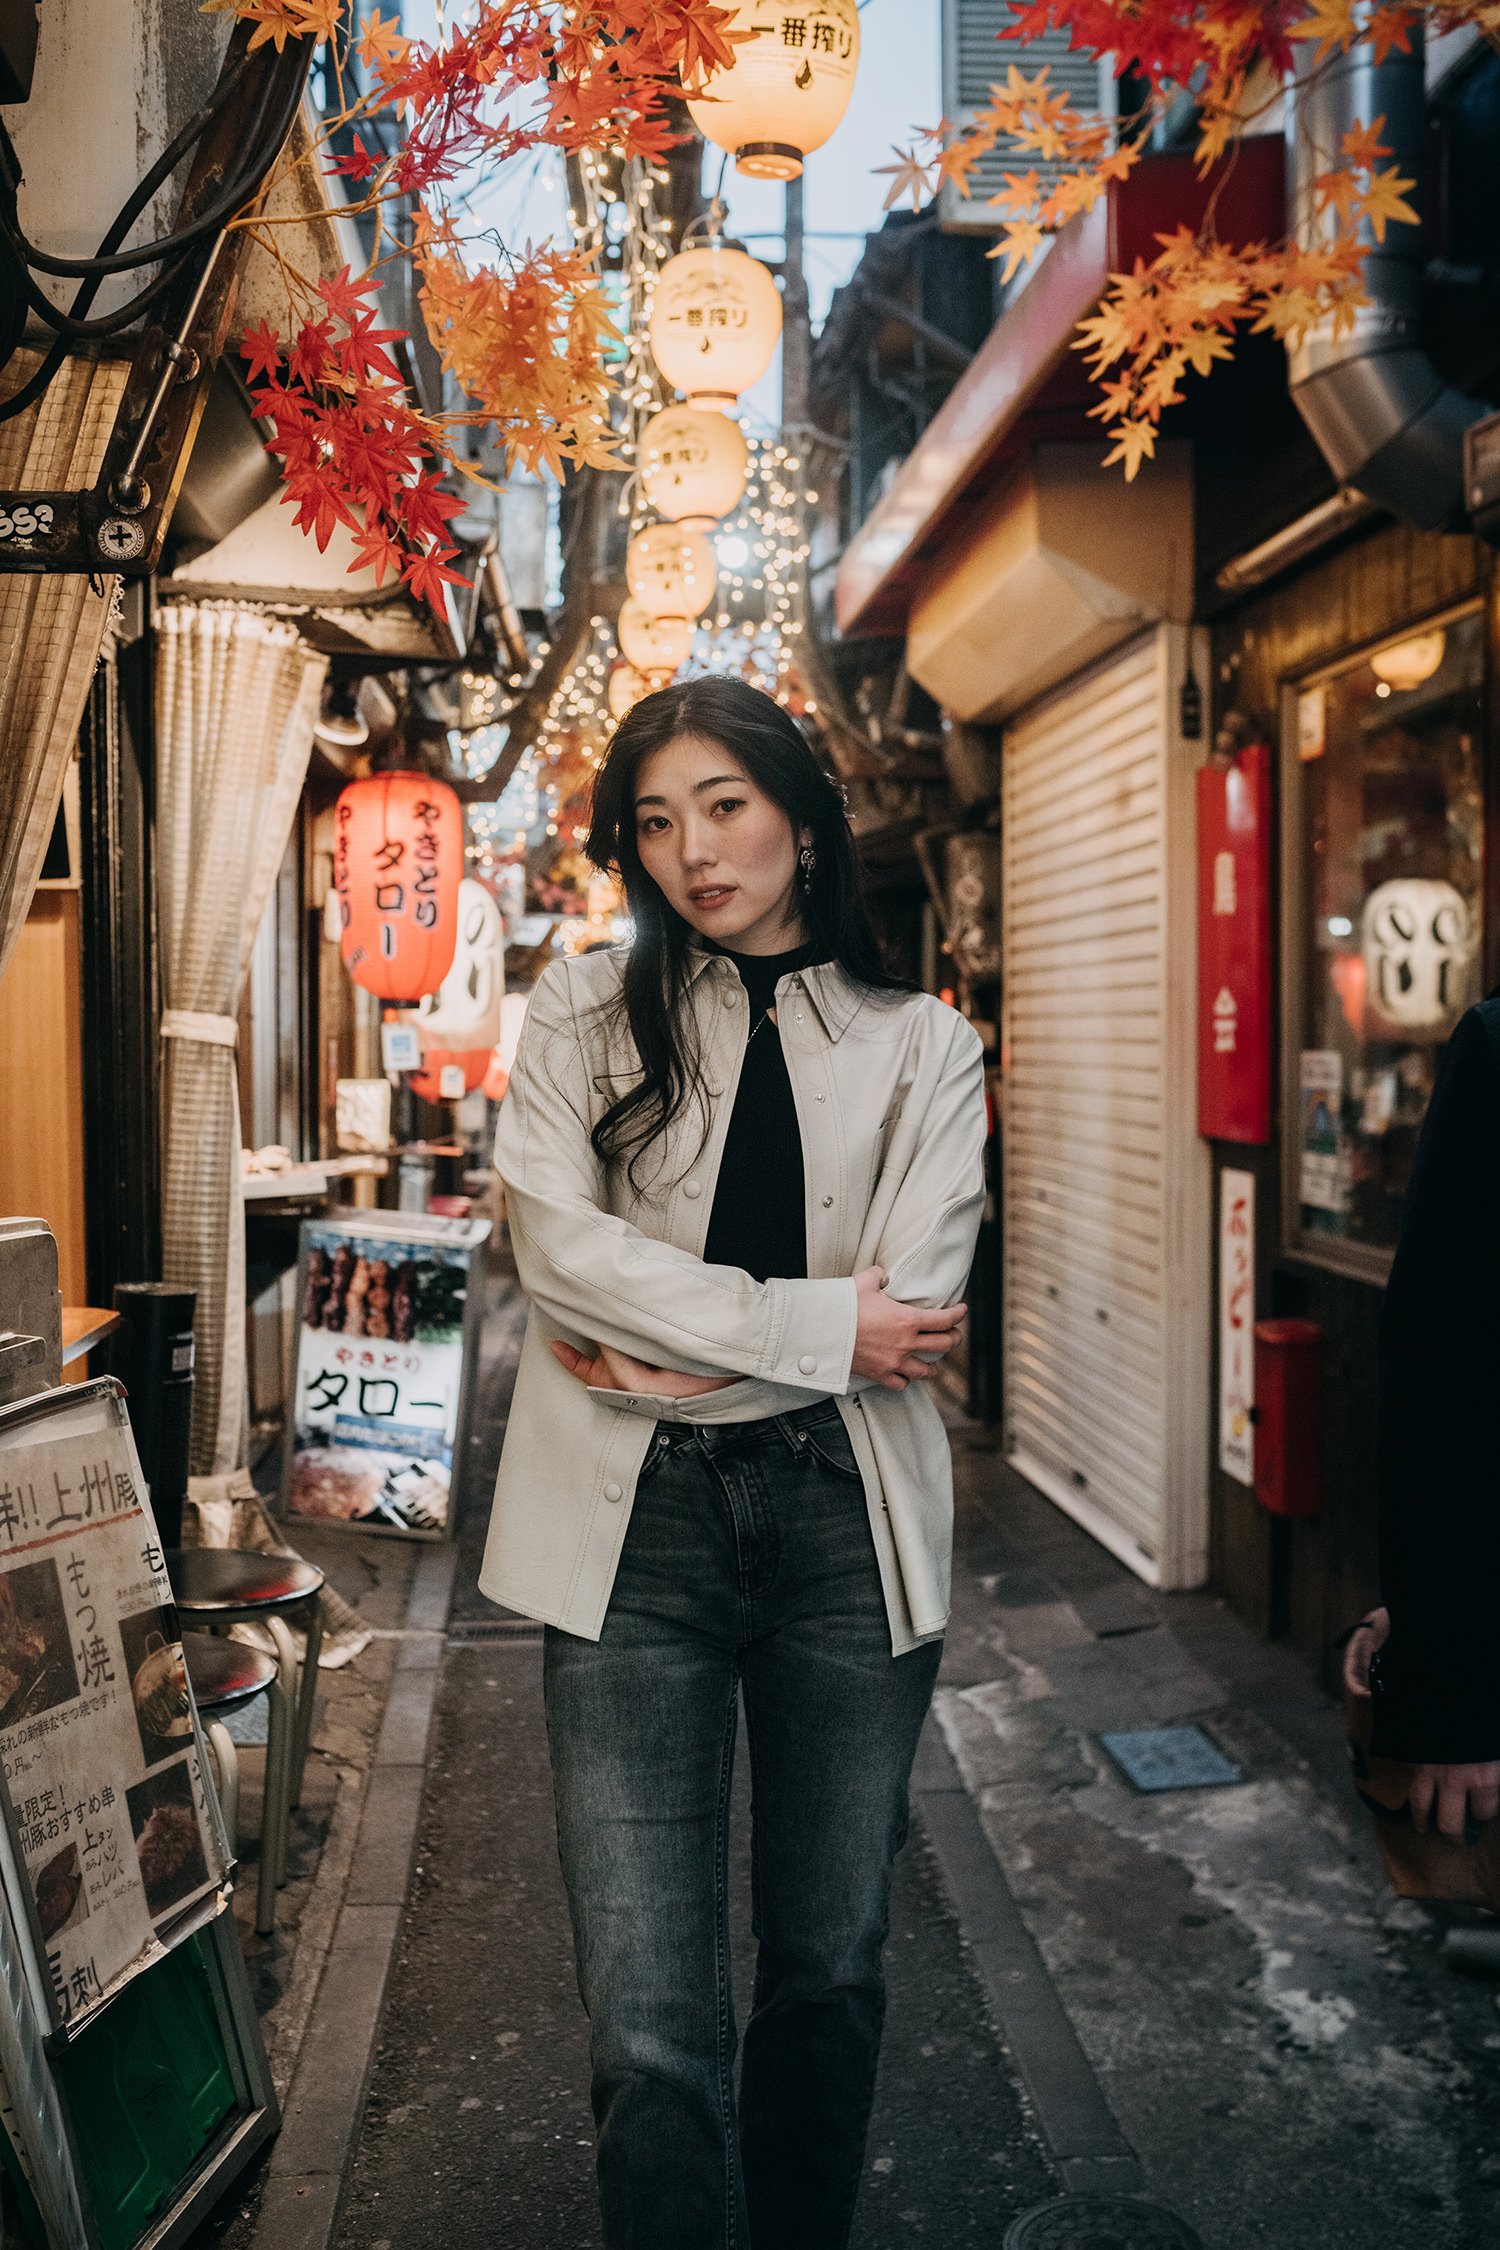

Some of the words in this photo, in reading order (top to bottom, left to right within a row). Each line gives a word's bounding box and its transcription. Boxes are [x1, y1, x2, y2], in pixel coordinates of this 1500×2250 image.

[750, 16, 852, 59] 一番搾り
[374, 840, 406, 956] タロー
[413, 800, 441, 928] やきとり
[307, 1368, 444, 1417] タロー
[335, 1347, 422, 1373] やきとり
[67, 1552, 115, 1688] もつ焼
